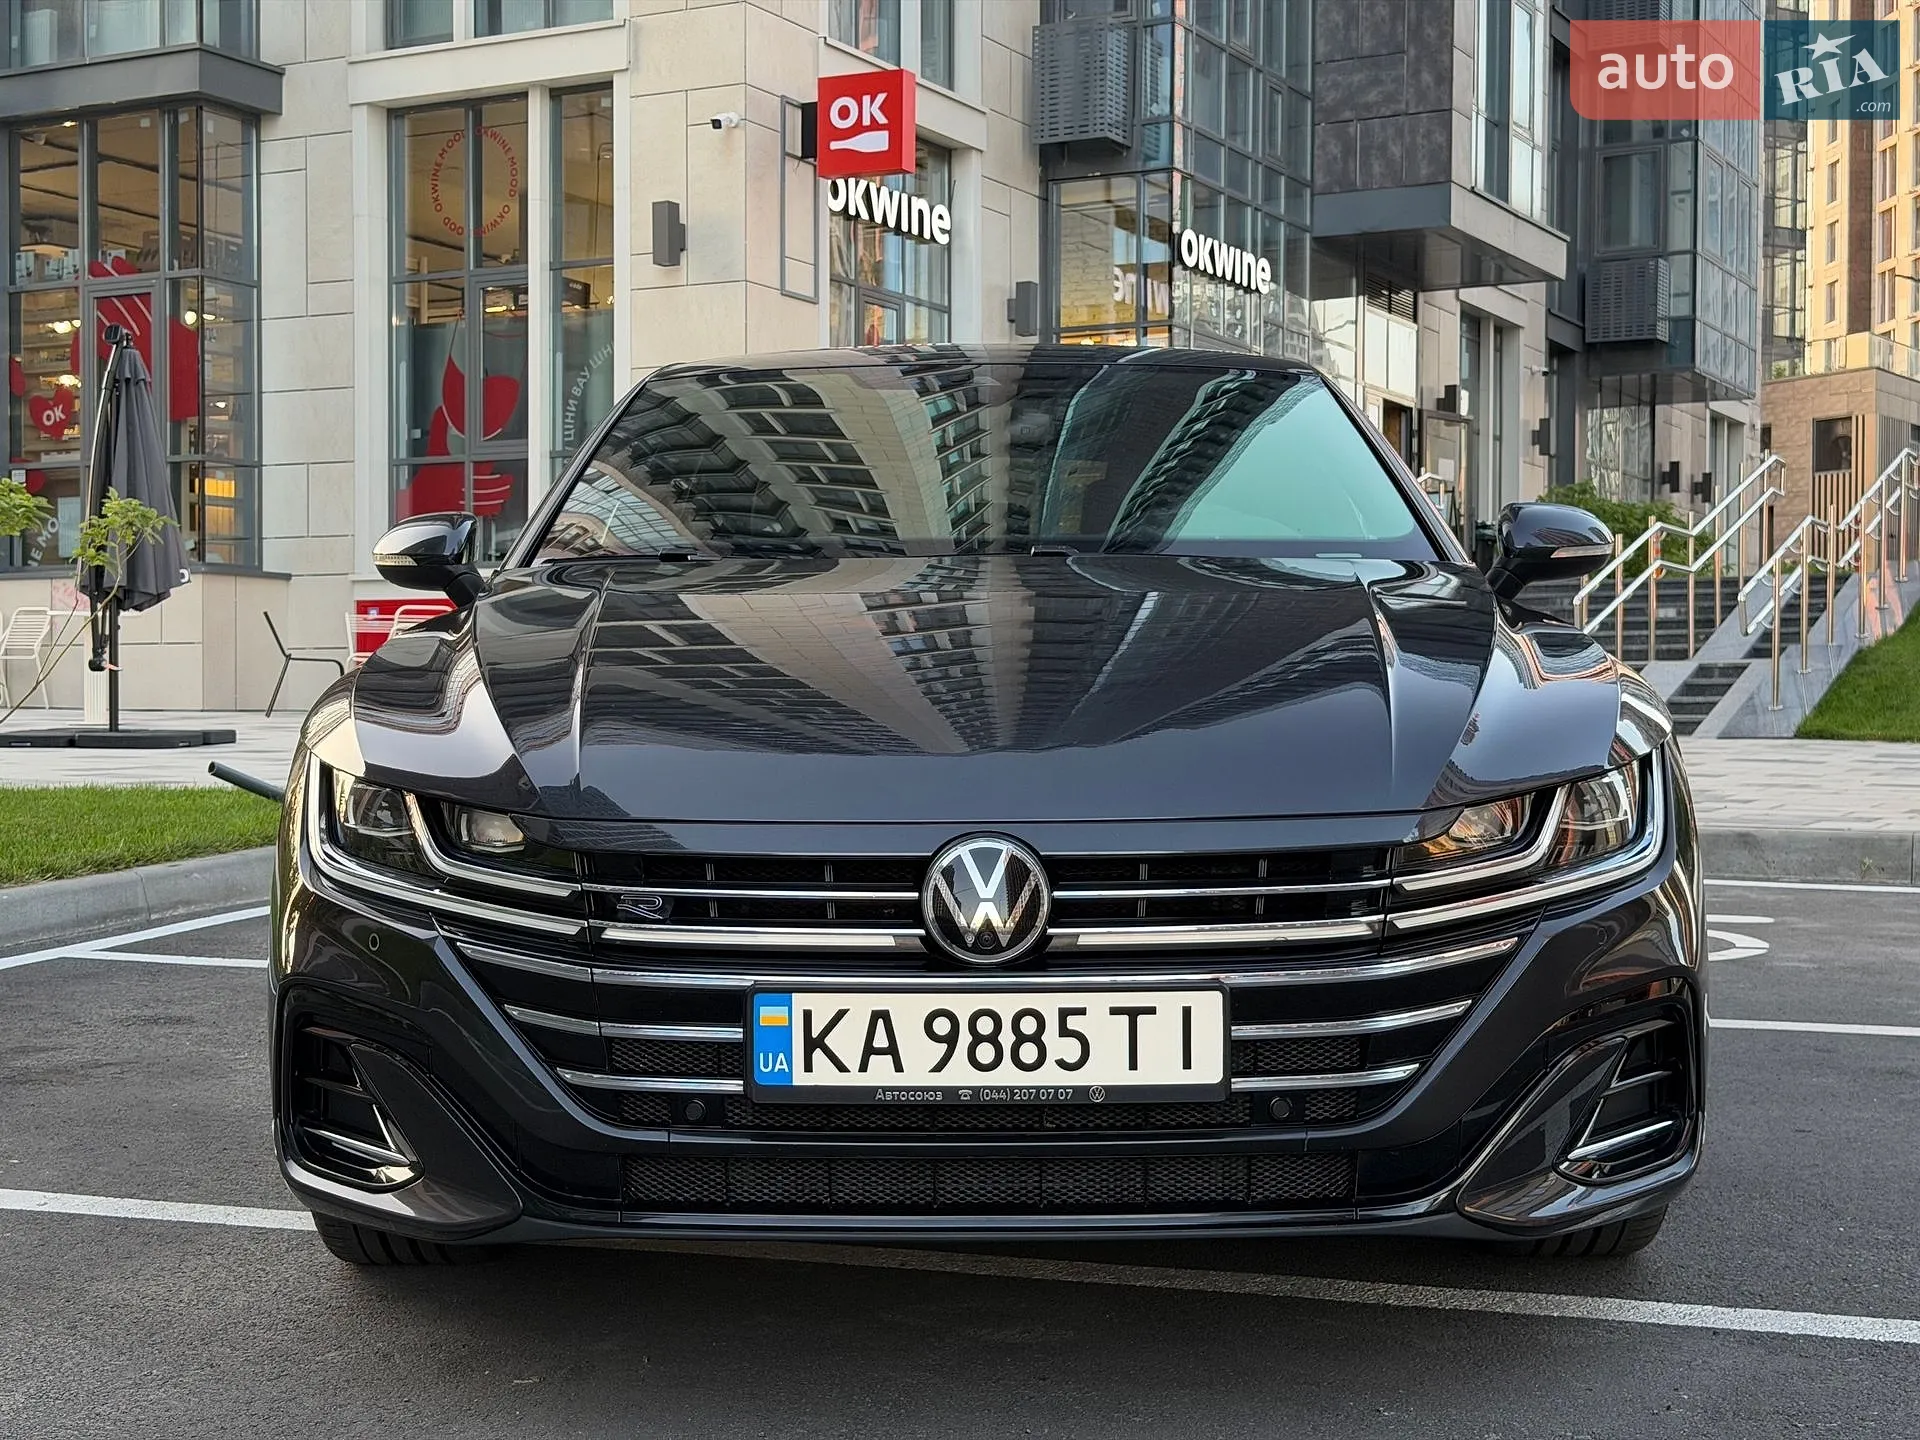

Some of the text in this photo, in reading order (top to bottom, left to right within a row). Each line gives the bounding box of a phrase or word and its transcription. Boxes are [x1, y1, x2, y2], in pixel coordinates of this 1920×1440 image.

[829, 92, 889, 129] OK
[443, 216, 464, 236] OOD
[42, 404, 66, 426] OK
[802, 1005, 1192, 1073] KA 9885 TI
[759, 1052, 789, 1073] UA
[979, 1088, 1010, 1101] (044)
[1013, 1088, 1036, 1100] 207
[1039, 1088, 1055, 1100] 07
[1058, 1088, 1073, 1100] 07
